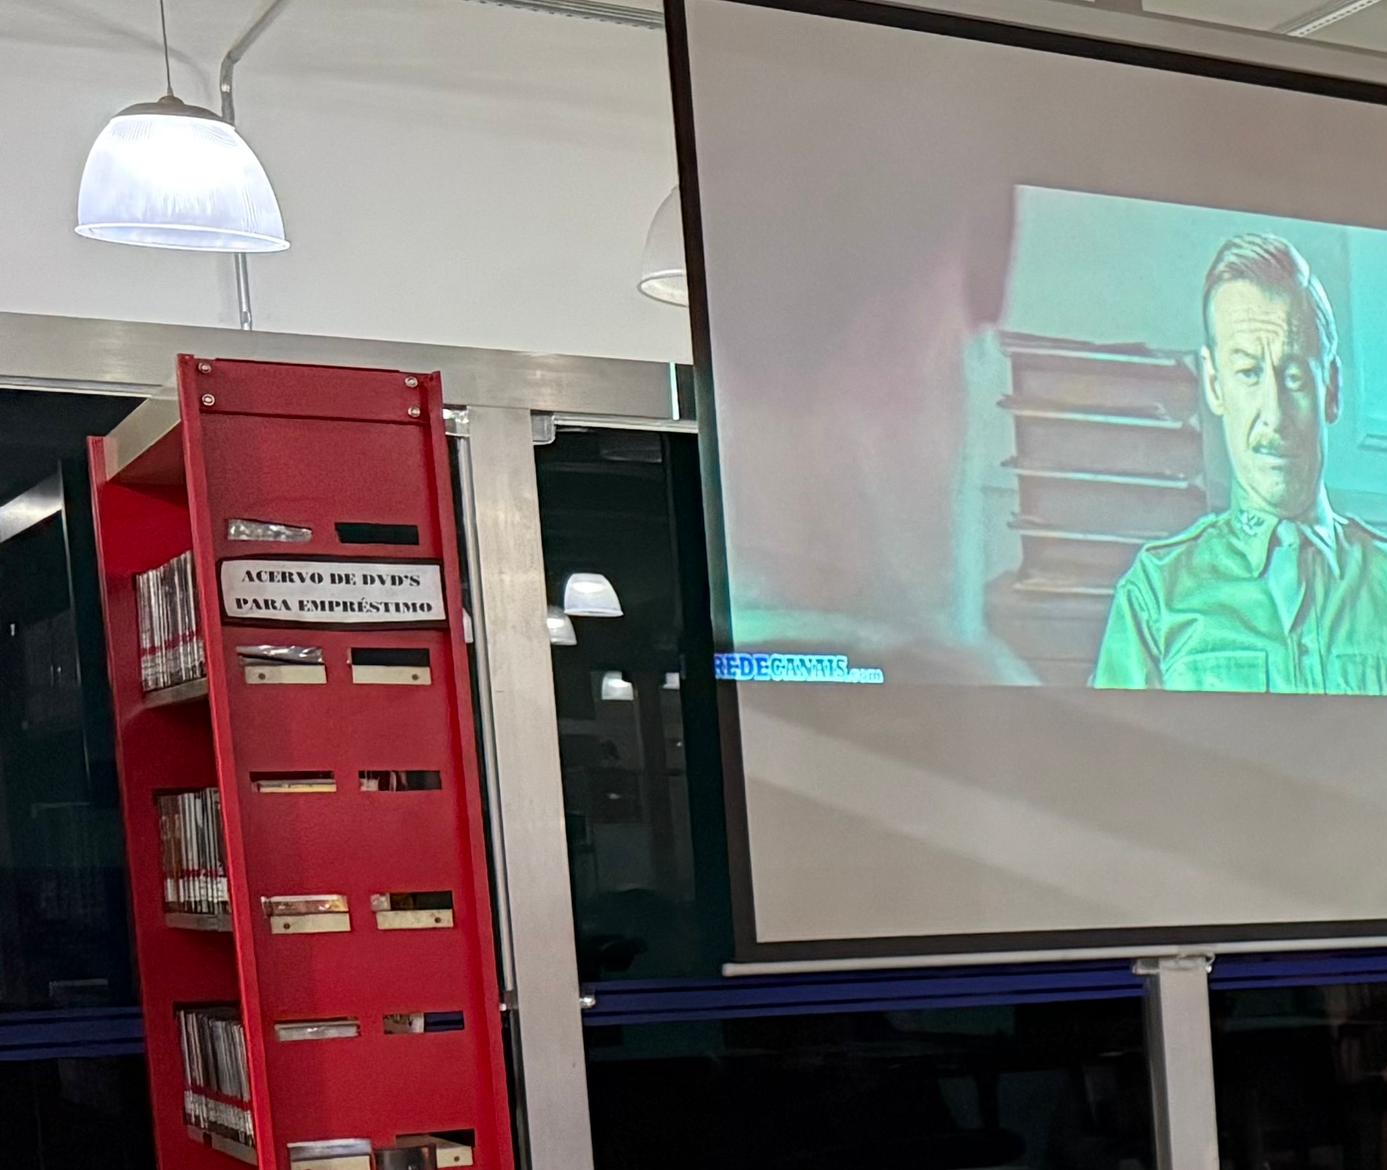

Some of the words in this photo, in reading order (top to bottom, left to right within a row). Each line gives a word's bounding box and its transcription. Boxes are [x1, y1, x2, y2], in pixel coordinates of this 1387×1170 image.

[241, 569, 324, 585] ACERVO
[329, 573, 357, 586] DE
[362, 574, 421, 587] DVD'S
[234, 597, 292, 612] PARA
[298, 596, 433, 613] EMPRÉSTIMO
